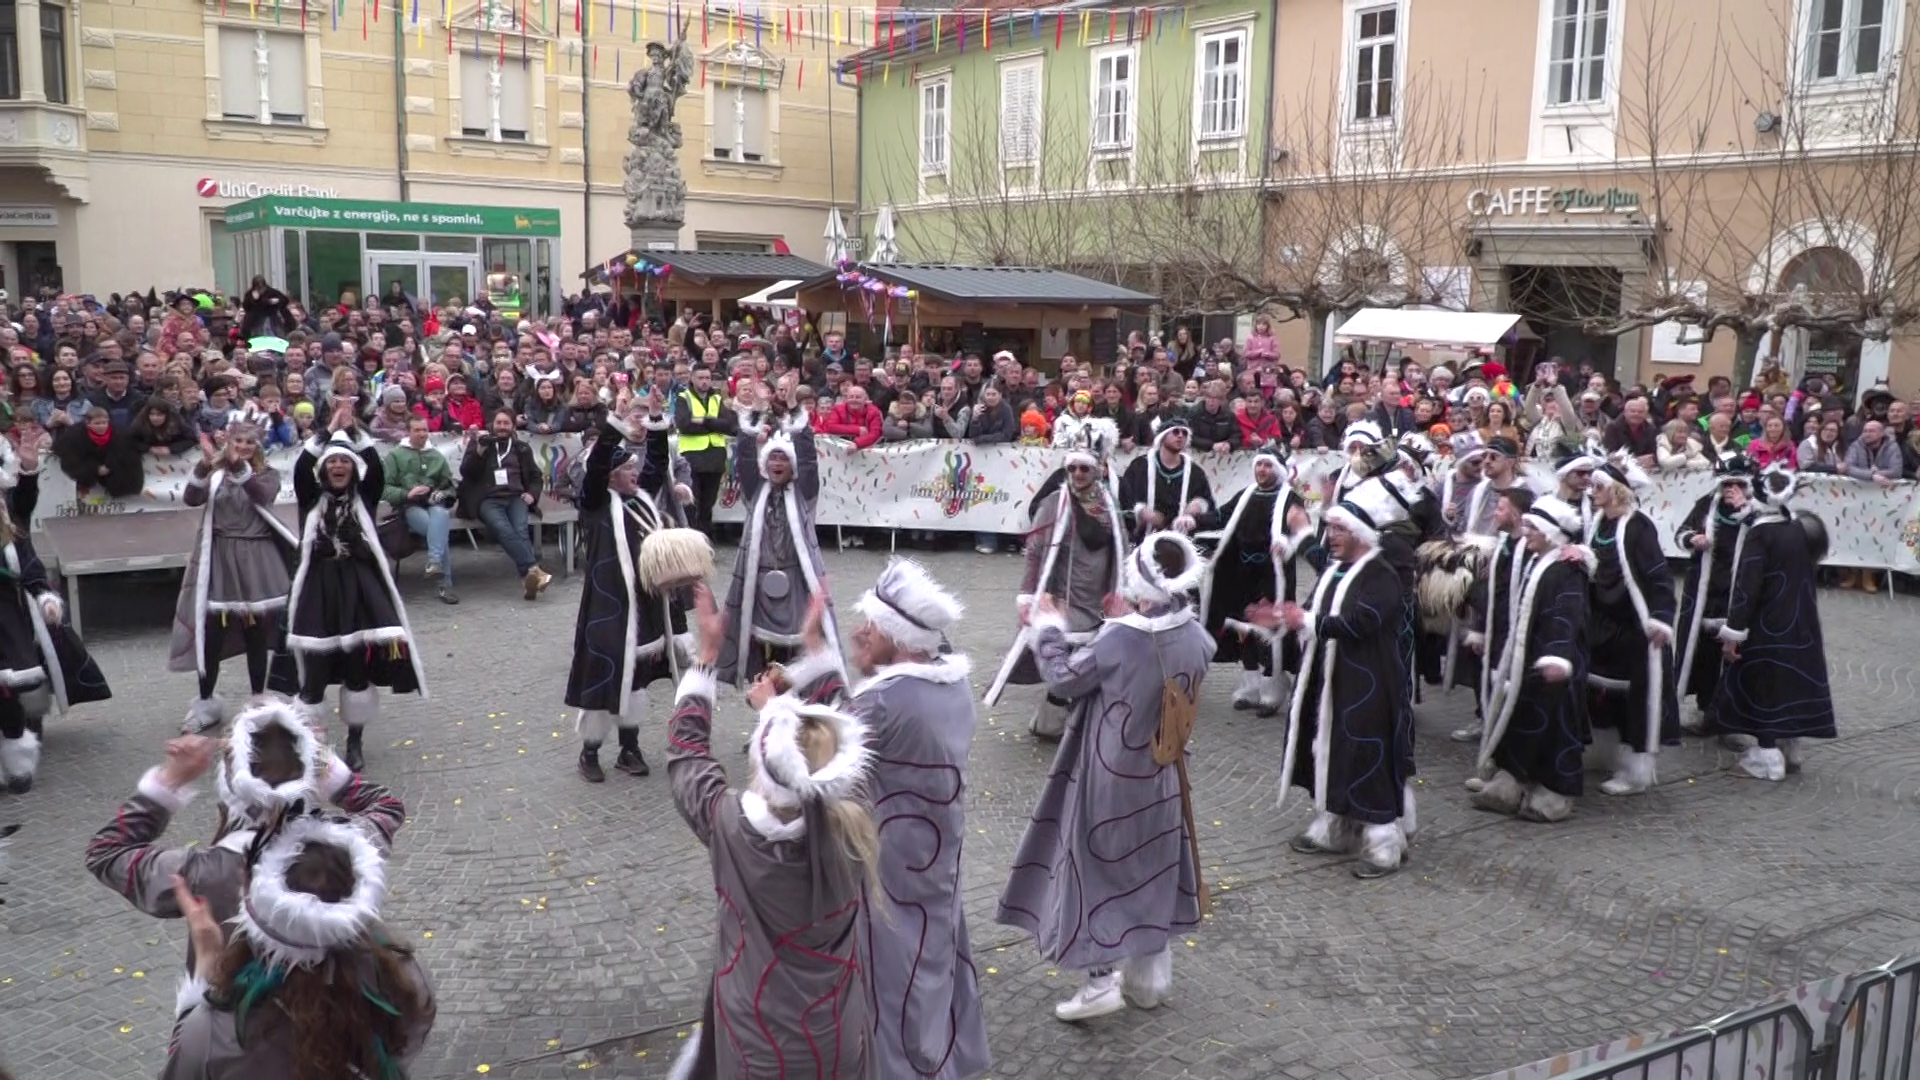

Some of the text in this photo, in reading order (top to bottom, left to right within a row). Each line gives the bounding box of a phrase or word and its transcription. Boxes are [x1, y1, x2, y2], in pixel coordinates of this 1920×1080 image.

[219, 181, 294, 198] UniCredit
[1467, 186, 1550, 216] CAFFE
[274, 206, 484, 226] Varčujte z energijo, ne s spomini.
